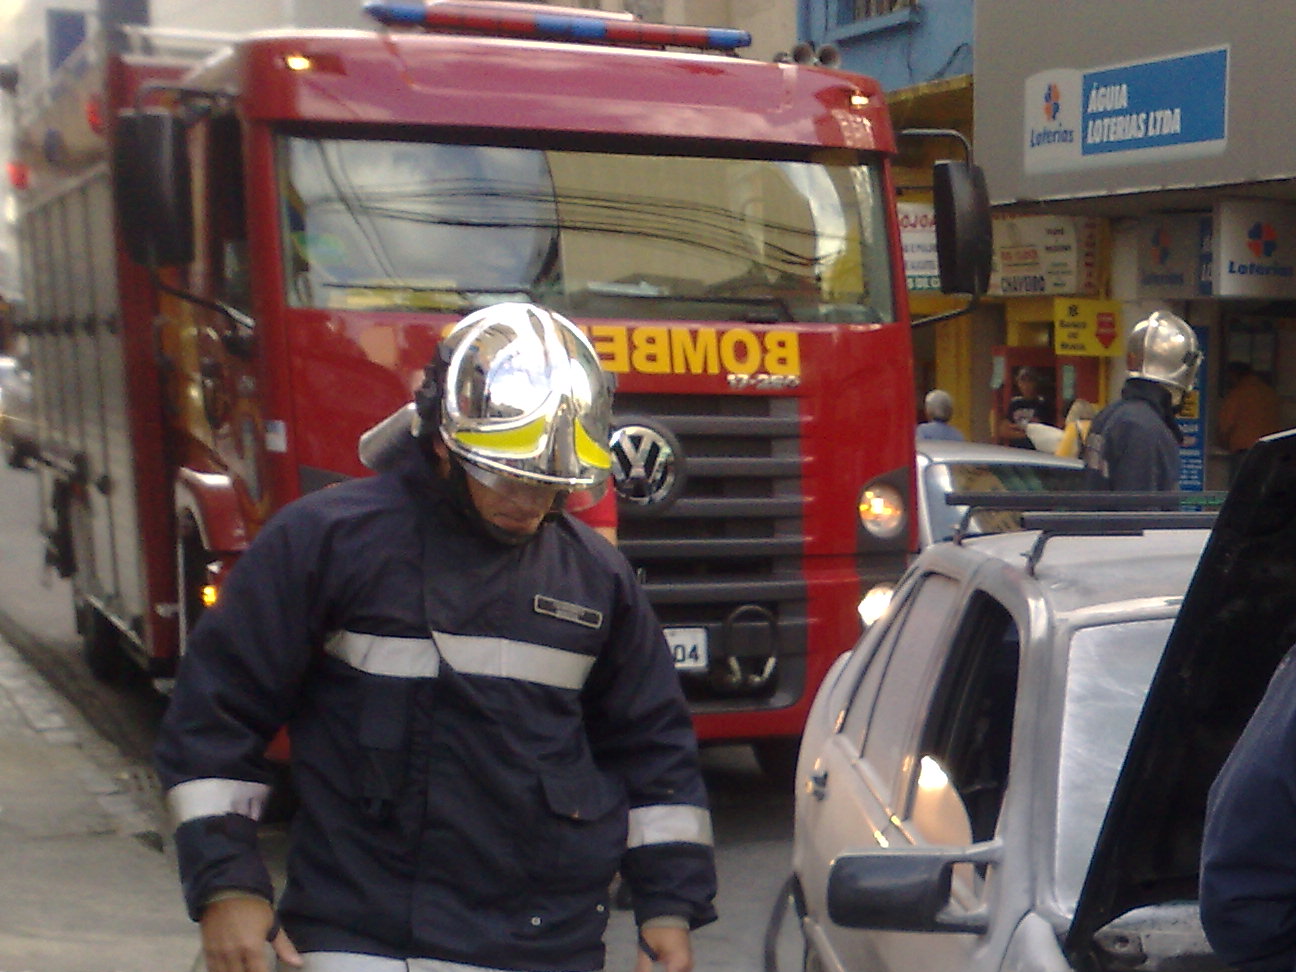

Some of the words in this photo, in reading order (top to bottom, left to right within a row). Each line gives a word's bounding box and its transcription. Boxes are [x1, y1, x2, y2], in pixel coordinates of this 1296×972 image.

[1088, 82, 1128, 113] ÁGUIA
[1030, 122, 1075, 148] Loterias
[1087, 113, 1147, 143] LOTERIAS
[1148, 108, 1182, 136] LTDA
